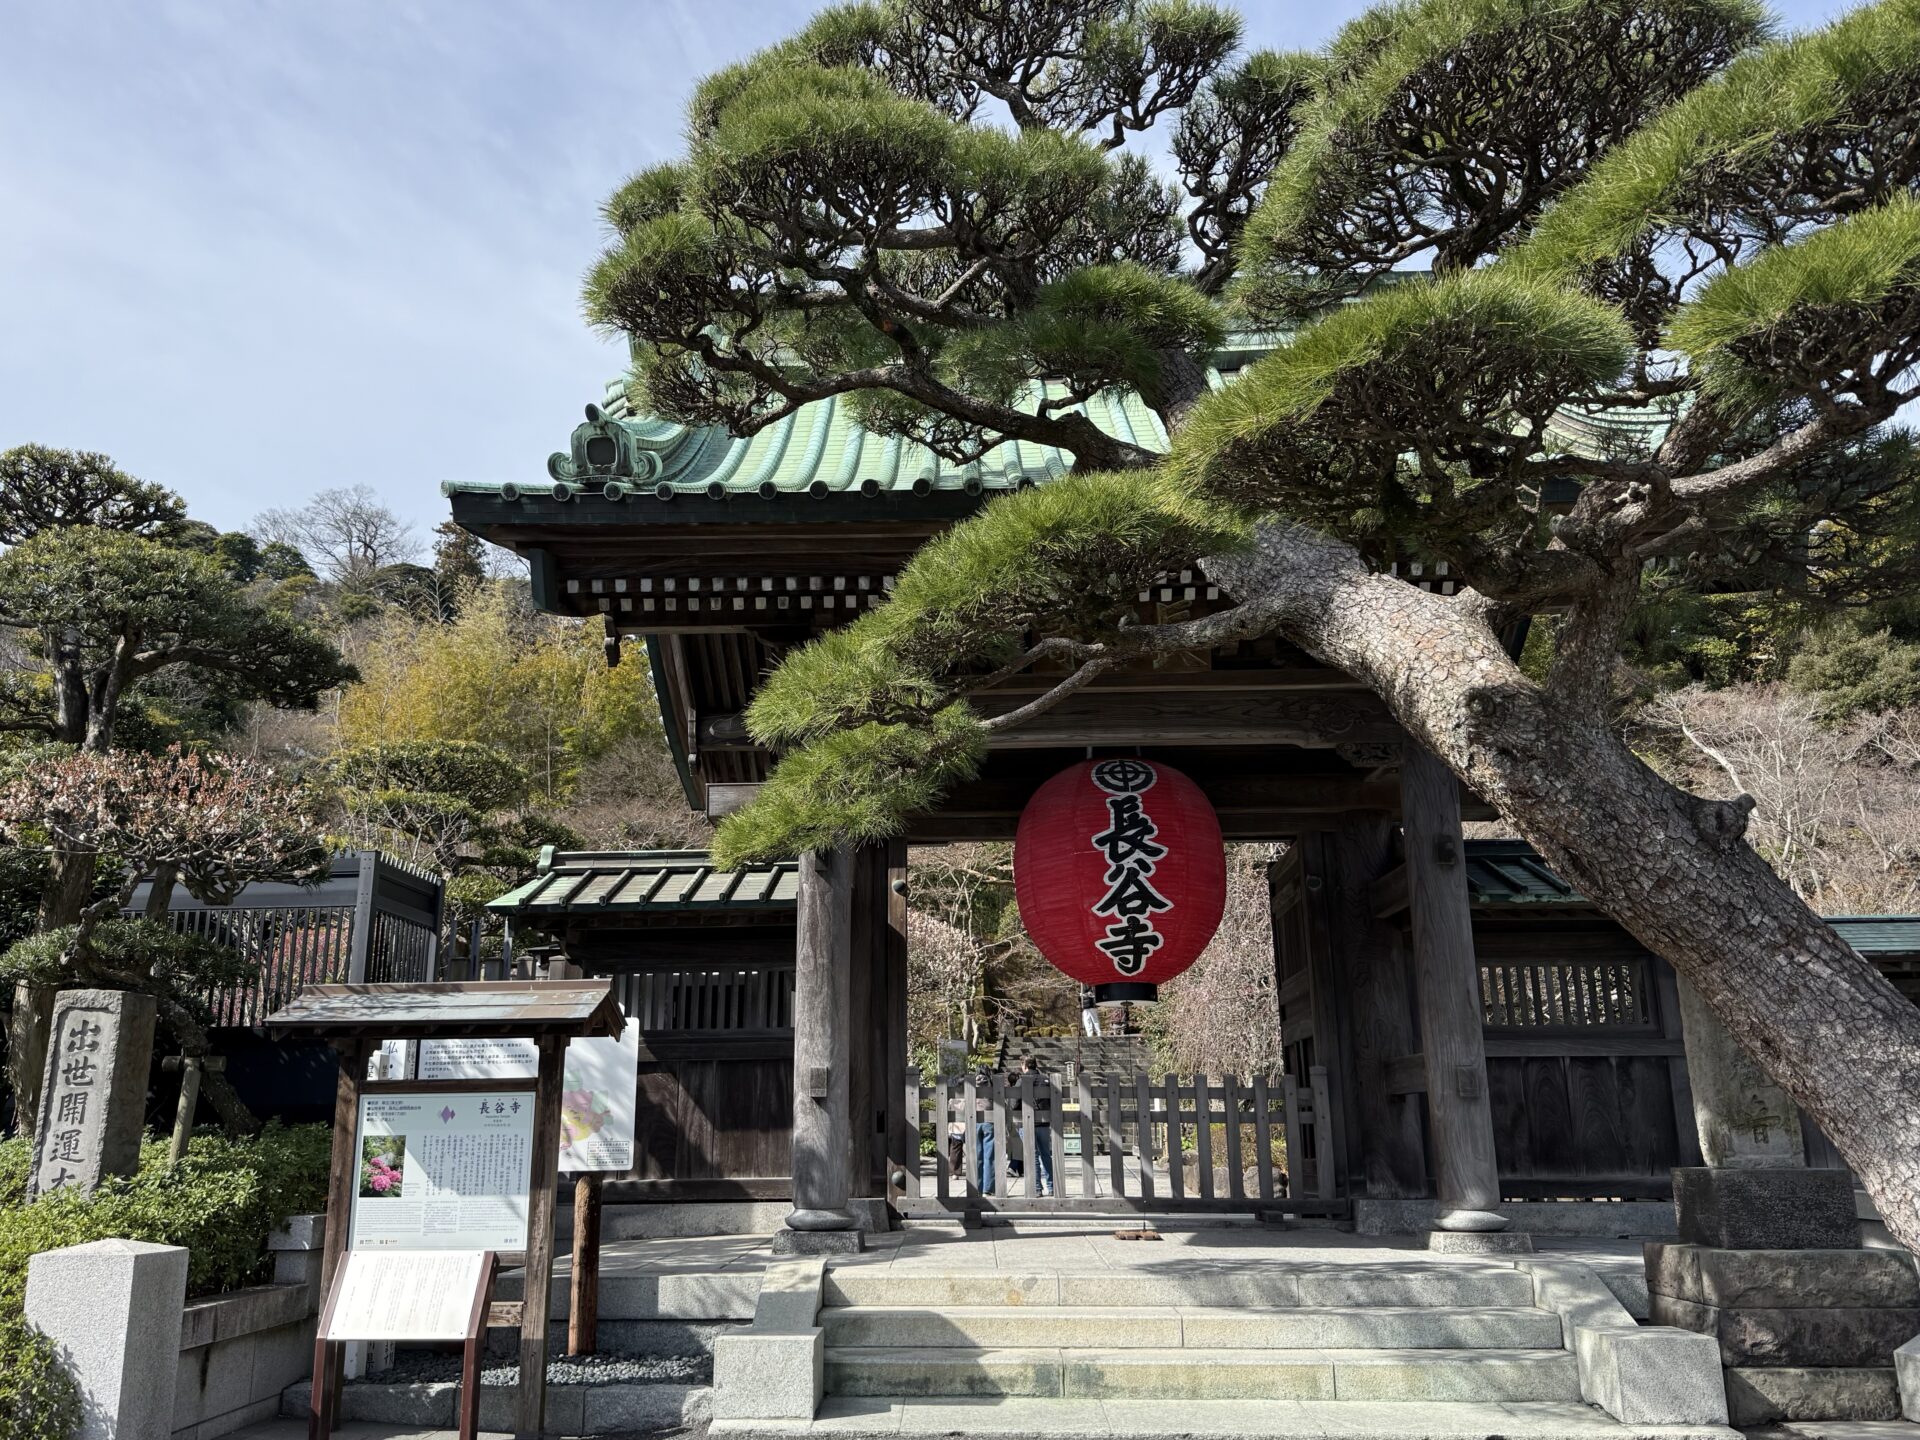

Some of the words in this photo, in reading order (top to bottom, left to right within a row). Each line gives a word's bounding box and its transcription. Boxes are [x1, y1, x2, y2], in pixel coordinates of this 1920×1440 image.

[1092, 794, 1174, 976] 長谷寺
[479, 1101, 521, 1114] 長谷寺
